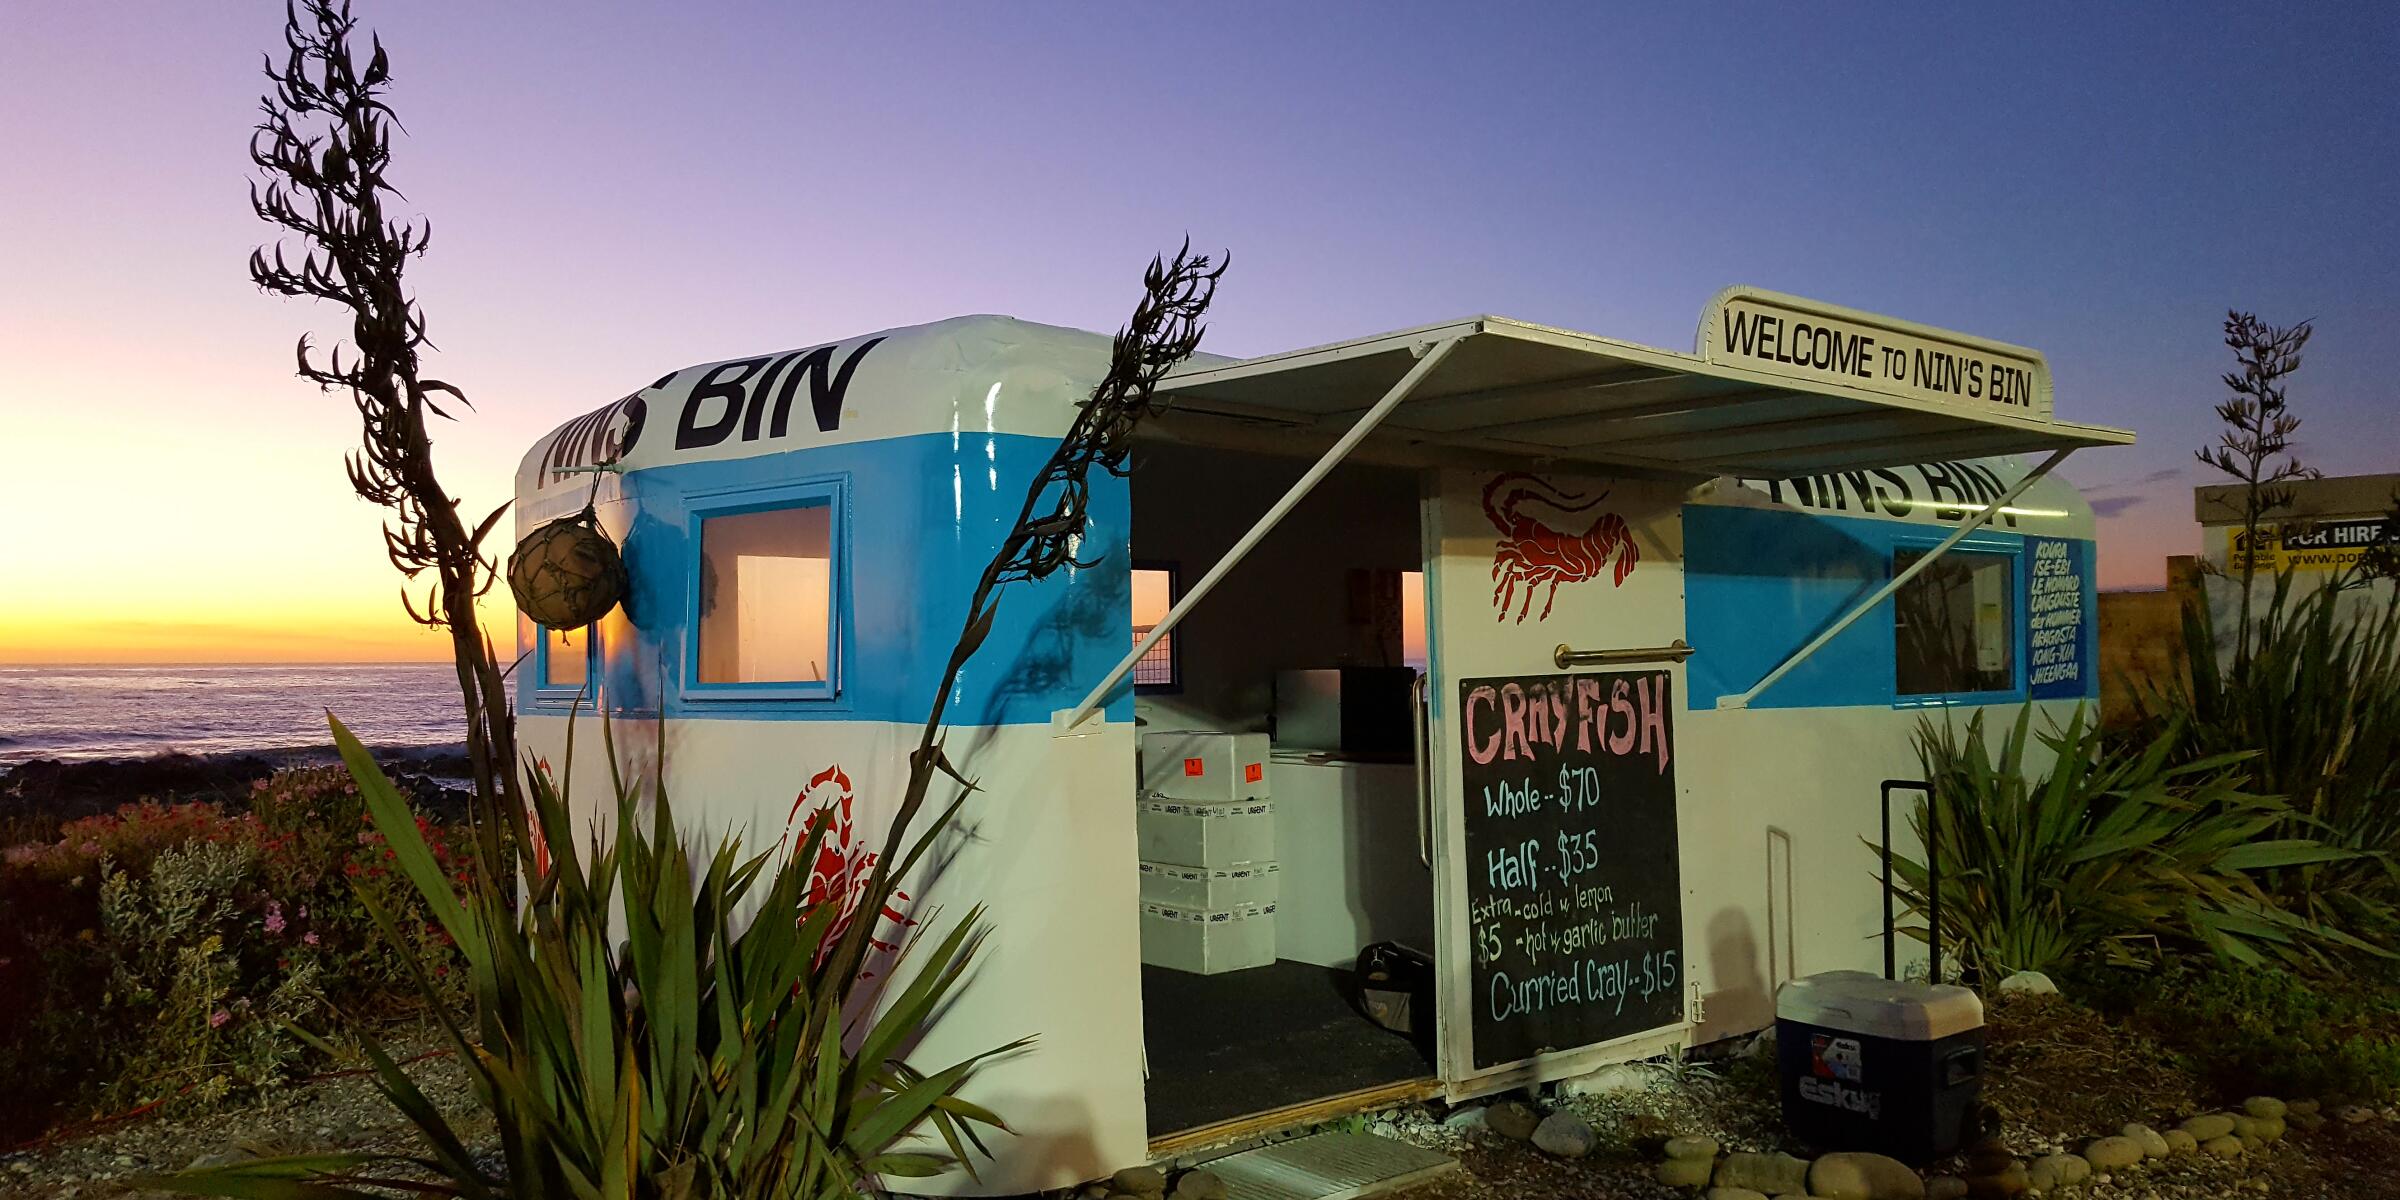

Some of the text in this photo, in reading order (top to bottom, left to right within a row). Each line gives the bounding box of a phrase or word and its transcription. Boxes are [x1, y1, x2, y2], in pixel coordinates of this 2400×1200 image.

[1724, 307, 2032, 407] WELCOME TO NIN'S BIN
[674, 335, 889, 450] BIN
[1916, 461, 2017, 528] BIN
[2032, 577, 2045, 595] LE
[2032, 625, 2077, 648] ARAGOSTA
[1247, 805, 1266, 815] URGENT
[1559, 762, 1600, 813] $70
[1231, 870, 1250, 879] URGENT
[1557, 829, 1599, 887] $35
[1209, 912, 1230, 922] URGENT
[1470, 894, 1512, 925] Extra
[1574, 883, 1614, 914] lemon
[1477, 922, 1502, 969] $5
[1562, 918, 1607, 955] garlic
[1611, 901, 1659, 942] butter
[1490, 960, 1581, 1022] Curried
[1640, 949, 1677, 1003] $15
